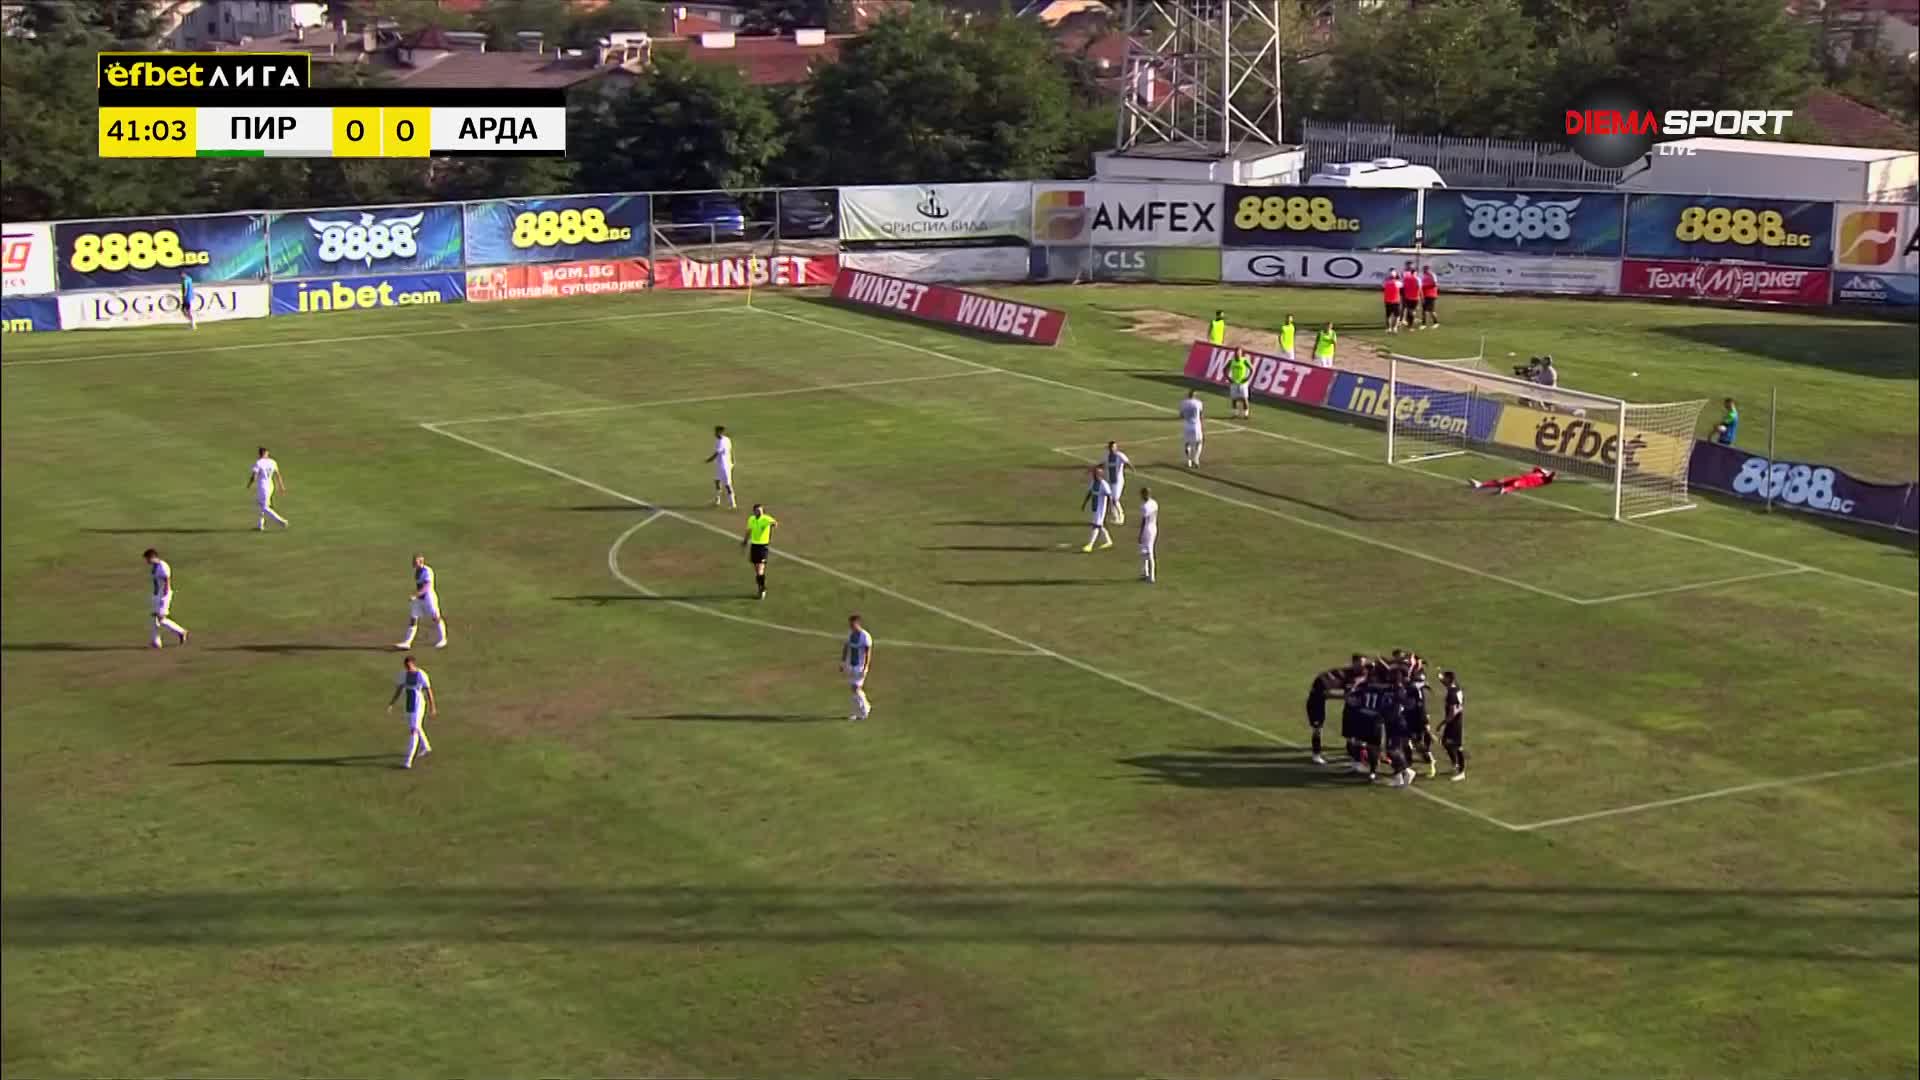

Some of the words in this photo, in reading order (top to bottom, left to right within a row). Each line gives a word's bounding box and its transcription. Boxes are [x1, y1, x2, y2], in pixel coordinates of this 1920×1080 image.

[1091, 201, 1216, 233] AMFEX
[1468, 203, 1572, 241] 8888
[1675, 206, 1812, 247] 8888.BG
[318, 221, 418, 263] 8888
[1103, 250, 1145, 269] CLS
[680, 255, 812, 289] WINBET
[1247, 254, 1364, 280] GIO
[297, 280, 442, 313] inbet.com
[848, 273, 929, 312] WINBET
[956, 294, 1049, 339] WINBET
